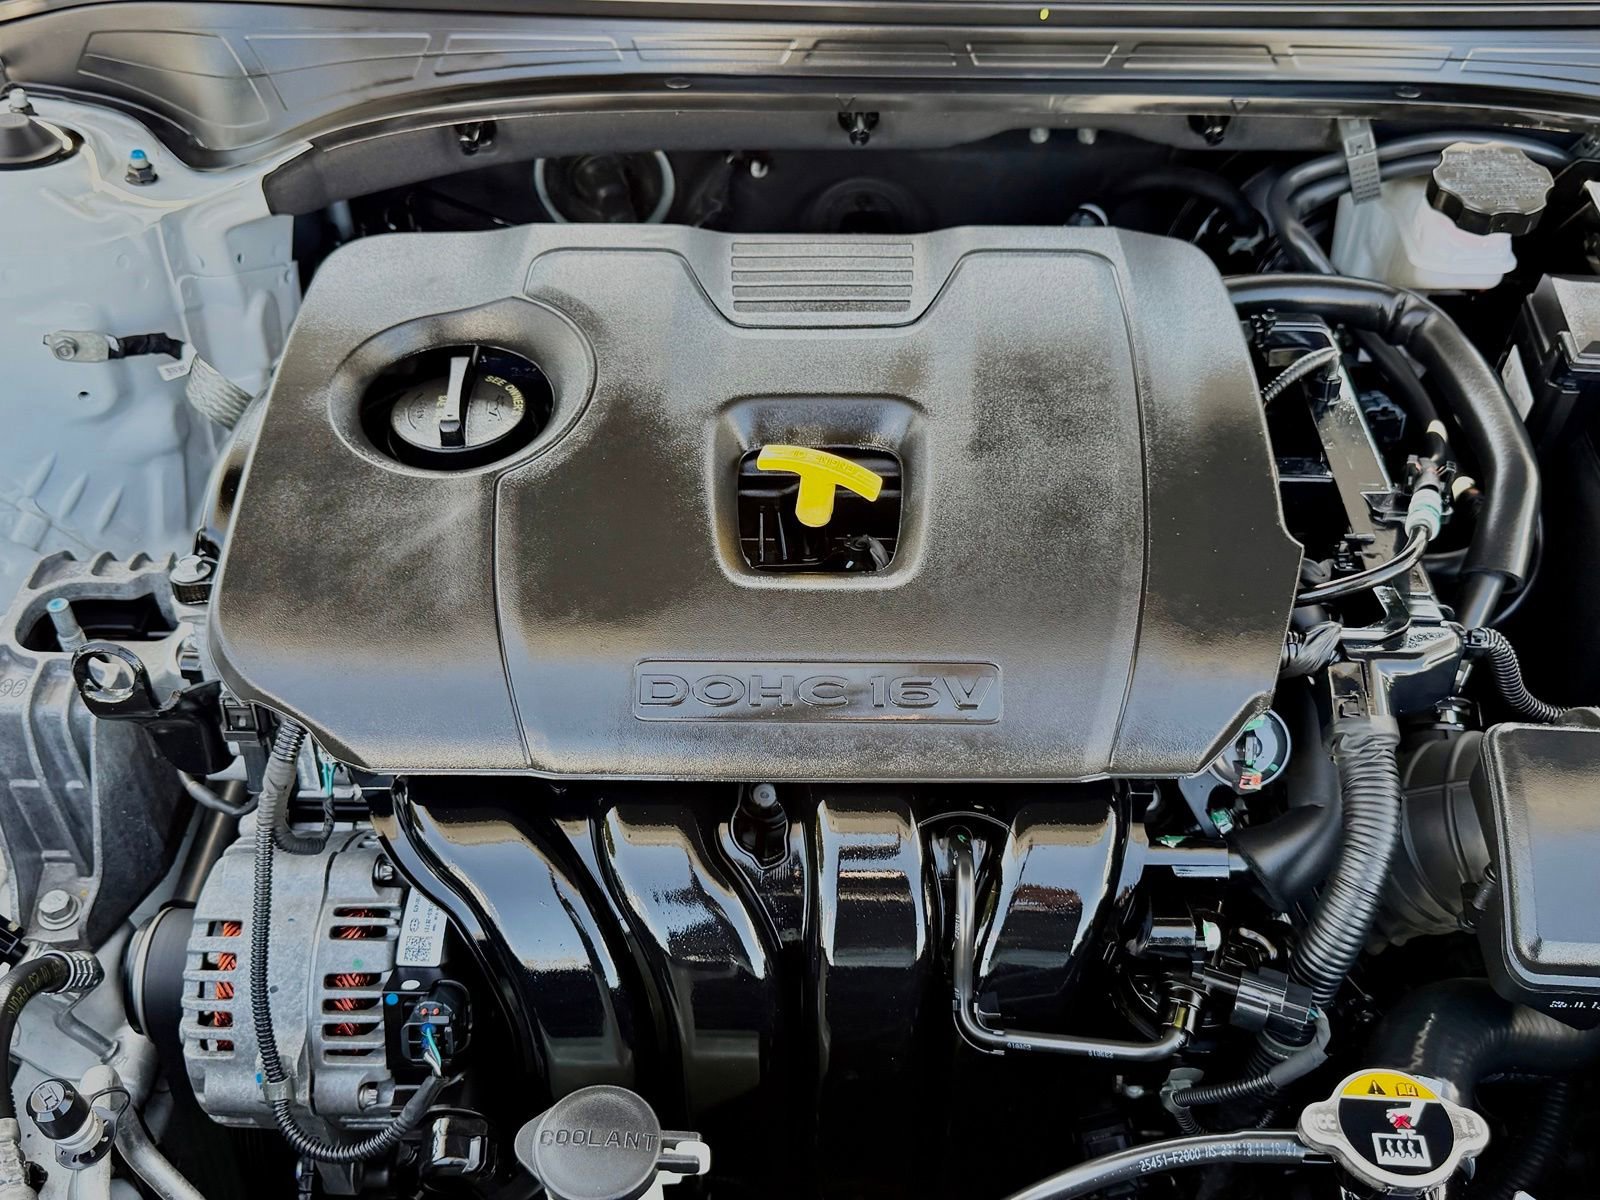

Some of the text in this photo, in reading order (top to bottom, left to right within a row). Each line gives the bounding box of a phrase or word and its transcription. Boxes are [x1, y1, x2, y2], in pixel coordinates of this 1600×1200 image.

[485, 375, 506, 386] SEE
[638, 673, 996, 711] DOHC 16V
[539, 1128, 658, 1152] COOLANT
[1139, 1148, 1201, 1172] 25451-F2000
